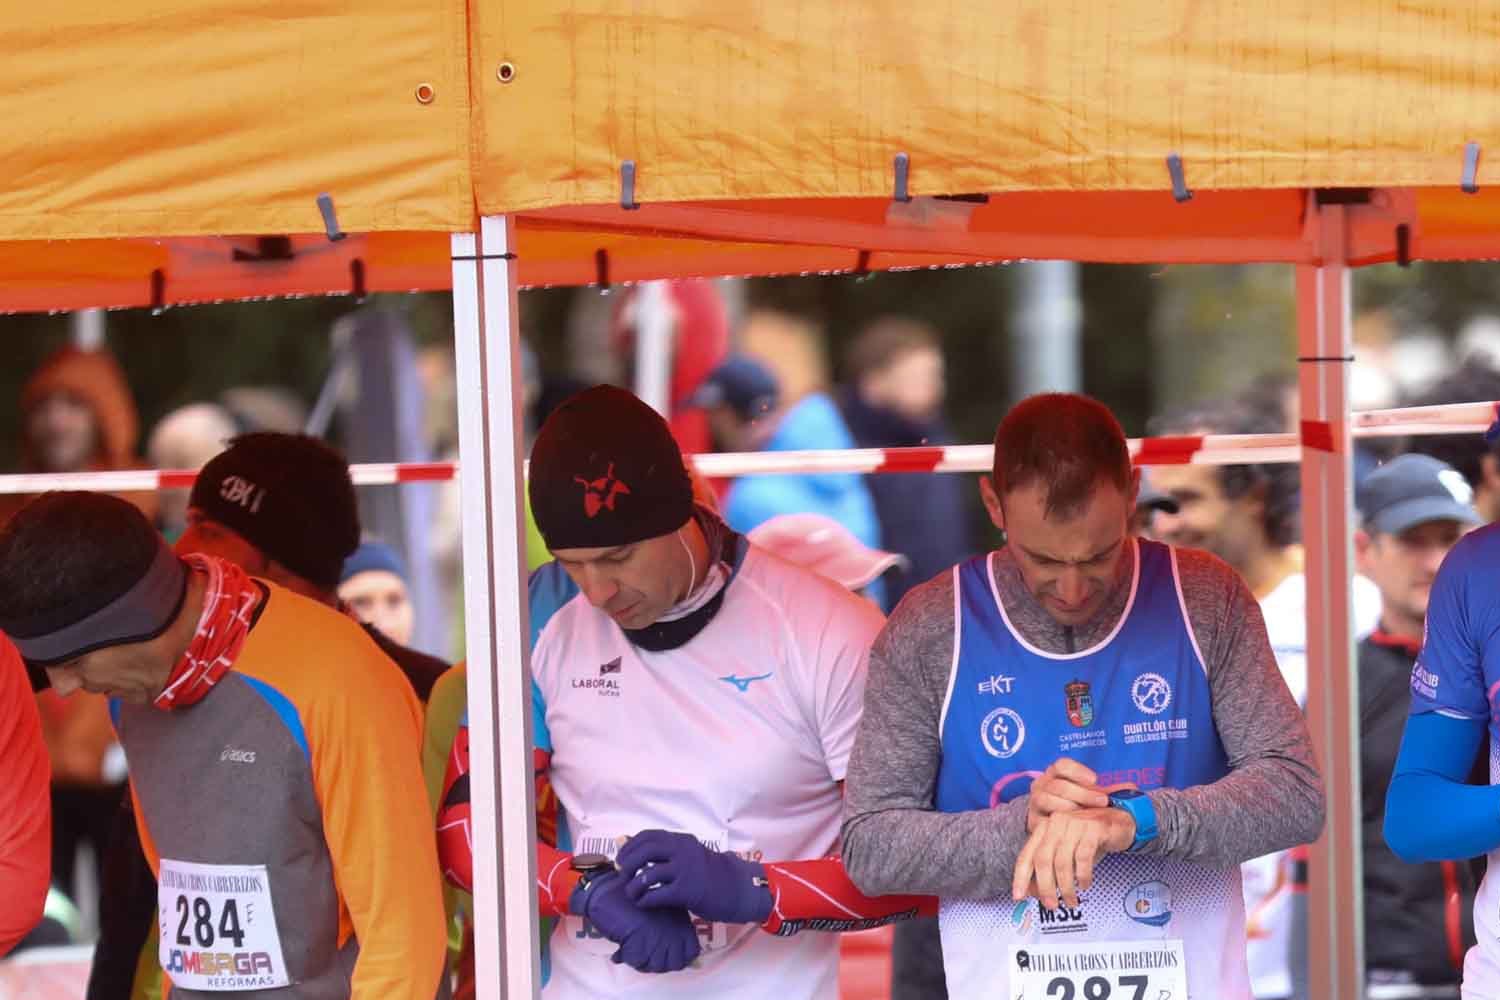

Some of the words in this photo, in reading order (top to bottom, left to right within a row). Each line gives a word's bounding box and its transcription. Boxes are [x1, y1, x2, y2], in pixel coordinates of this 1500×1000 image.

[572, 680, 620, 688] LABORAL
[176, 894, 245, 948] 284
[166, 949, 273, 975] JOMISAGA
[1049, 952, 1071, 971] LIGA
[1074, 952, 1109, 971] CROSS
[1110, 950, 1178, 969] CABRERIZOS
[207, 976, 274, 988] REFORMAS
